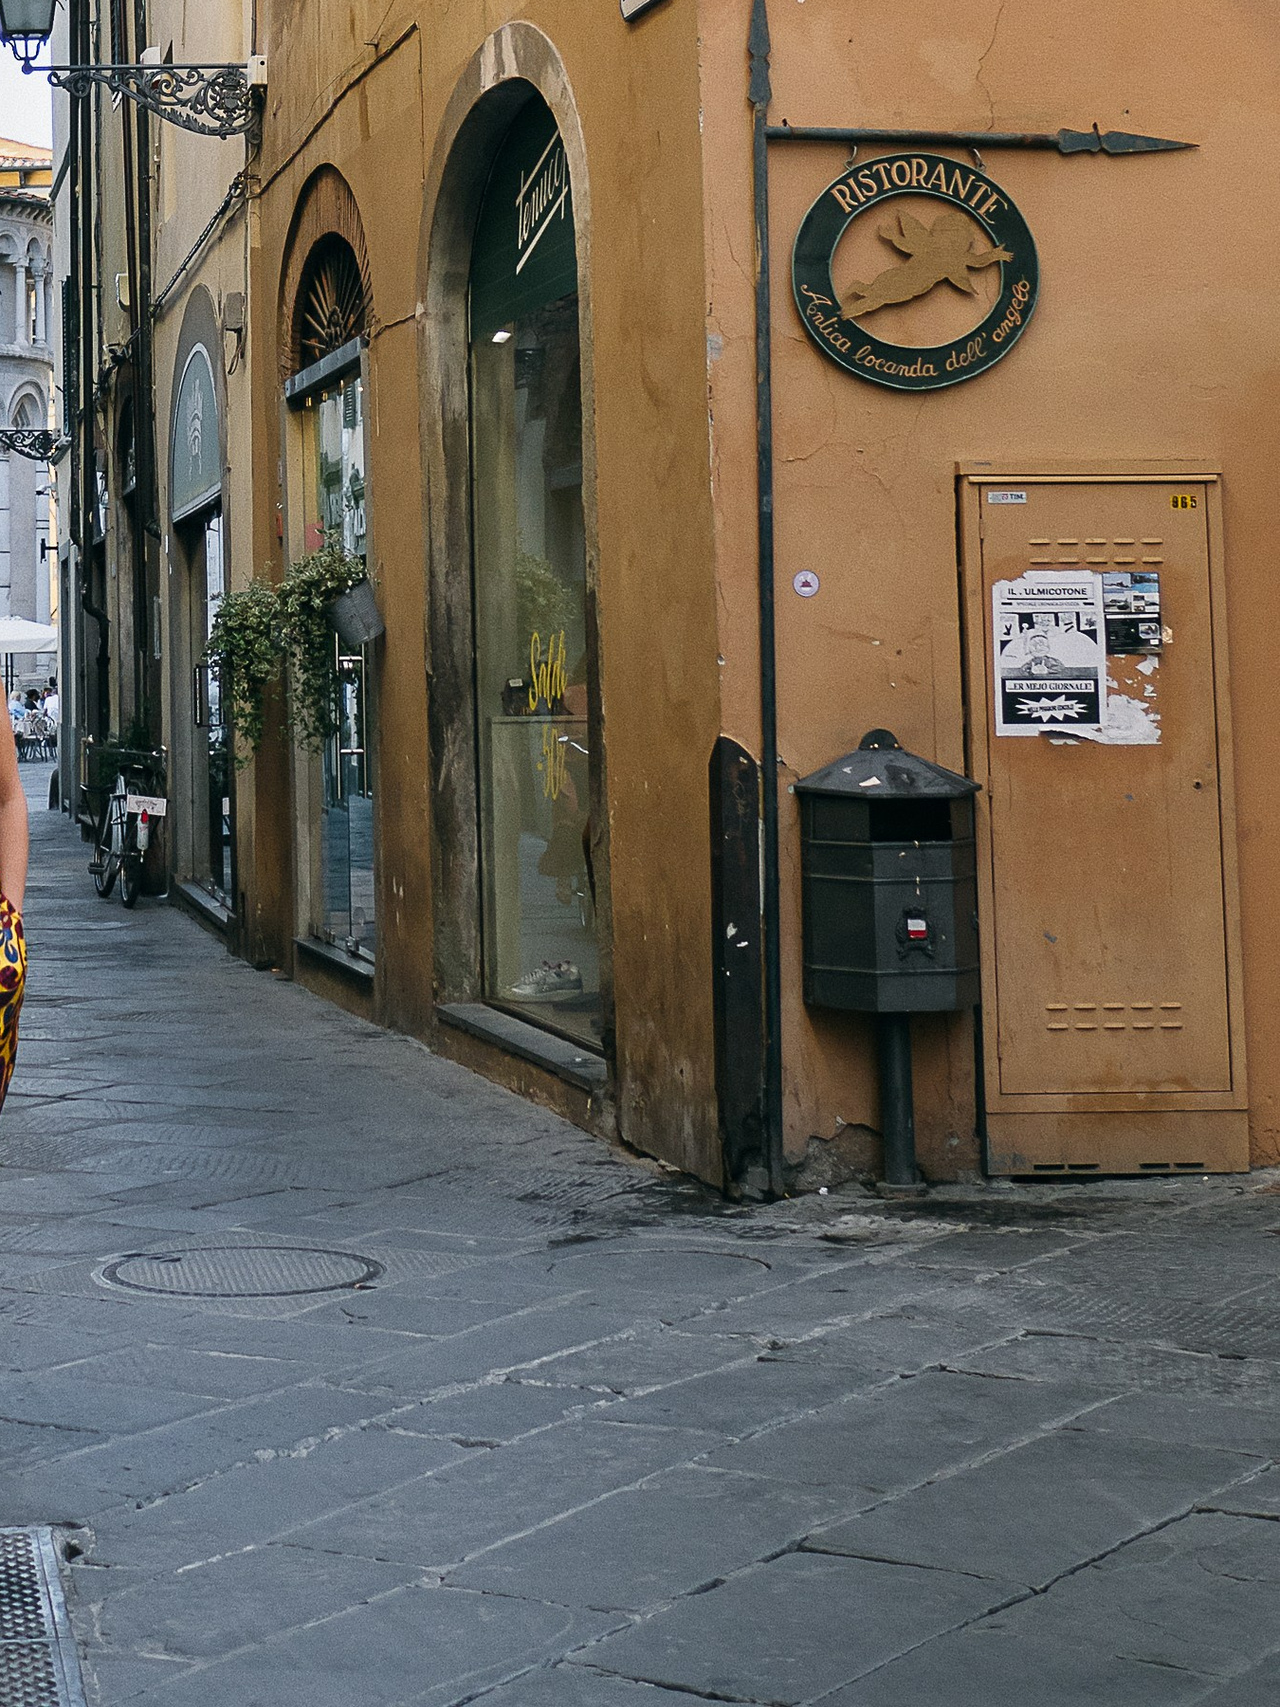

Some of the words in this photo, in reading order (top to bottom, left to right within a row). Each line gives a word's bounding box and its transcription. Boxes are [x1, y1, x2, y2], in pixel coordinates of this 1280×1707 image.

[830, 158, 1008, 224] RISTORANTE
[800, 283, 851, 354] Antica
[852, 345, 938, 378] locanda
[992, 274, 1031, 343] angelo
[1019, 587, 1087, 596] ULMICOTONE
